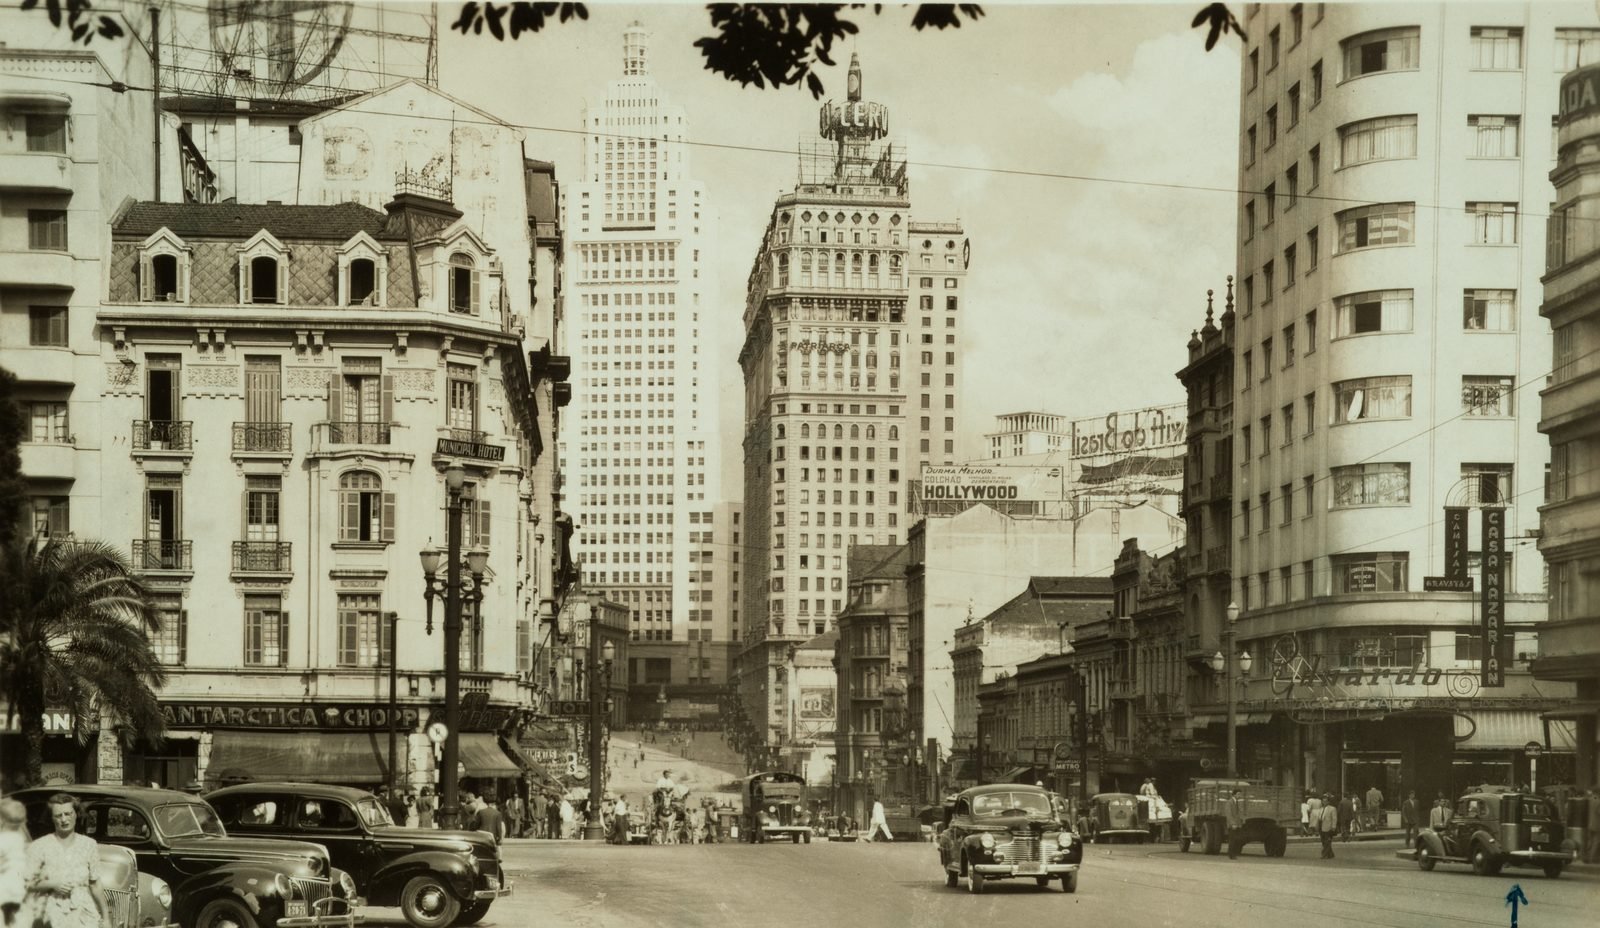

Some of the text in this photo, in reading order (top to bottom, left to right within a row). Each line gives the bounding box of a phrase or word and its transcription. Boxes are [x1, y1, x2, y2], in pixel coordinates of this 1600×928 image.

[438, 439, 504, 460] MUNICIPAL HOTEL
[924, 485, 1018, 500] HOLLYWOOD
[1451, 512, 1461, 577] CAMISAS
[1487, 512, 1499, 686] CASA NAZARIAN
[163, 705, 418, 726] ANTARCTICA CHOPP
[552, 702, 610, 715] HOTL
